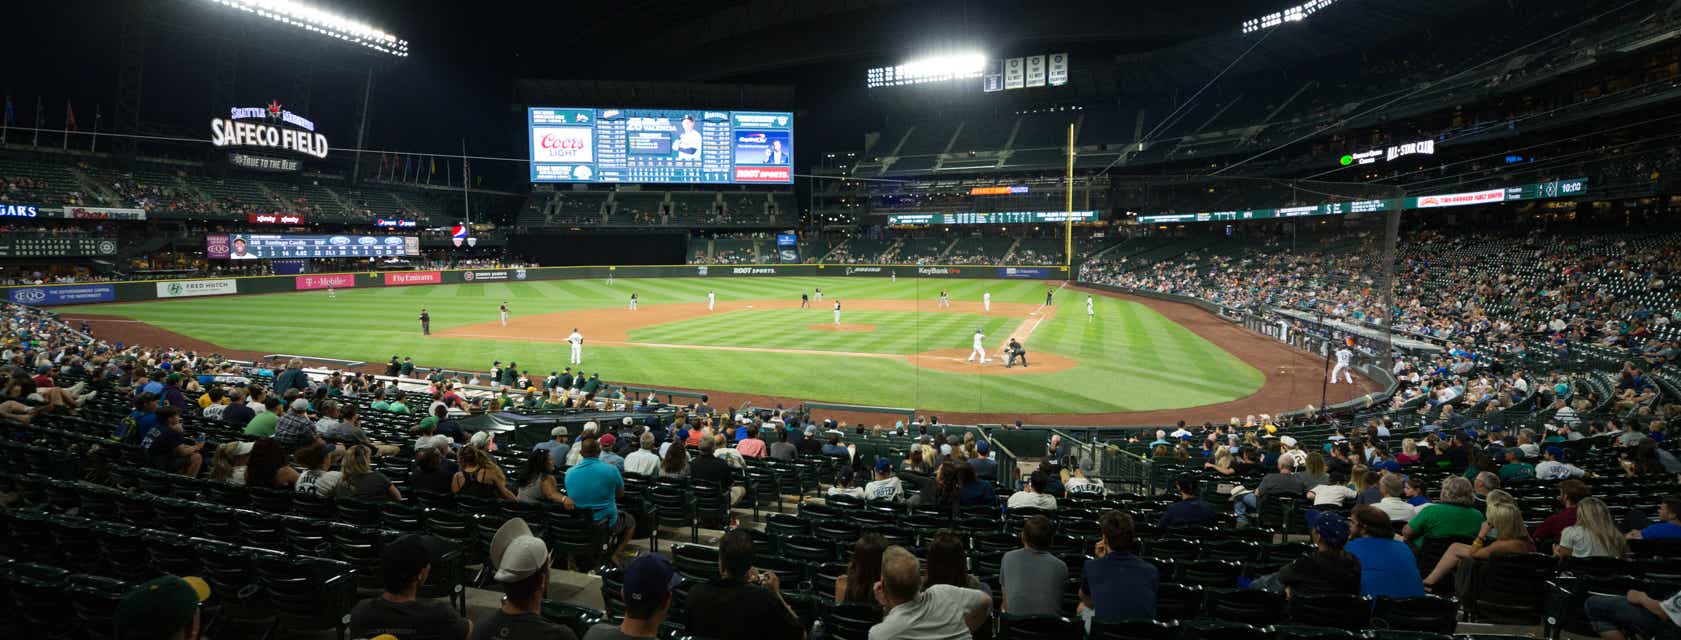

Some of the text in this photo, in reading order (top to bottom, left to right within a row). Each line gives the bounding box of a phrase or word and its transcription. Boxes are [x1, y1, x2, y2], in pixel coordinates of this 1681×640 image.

[211, 117, 328, 159] SAFECO FIELD
[541, 132, 584, 150] Coors
[1416, 140, 1435, 155] CLUB
[549, 149, 577, 157] LIGHT
[281, 160, 297, 170] BLUE
[736, 169, 760, 178] ROOT
[919, 267, 949, 275] KeyBank
[393, 273, 433, 282] Fly Emirates
